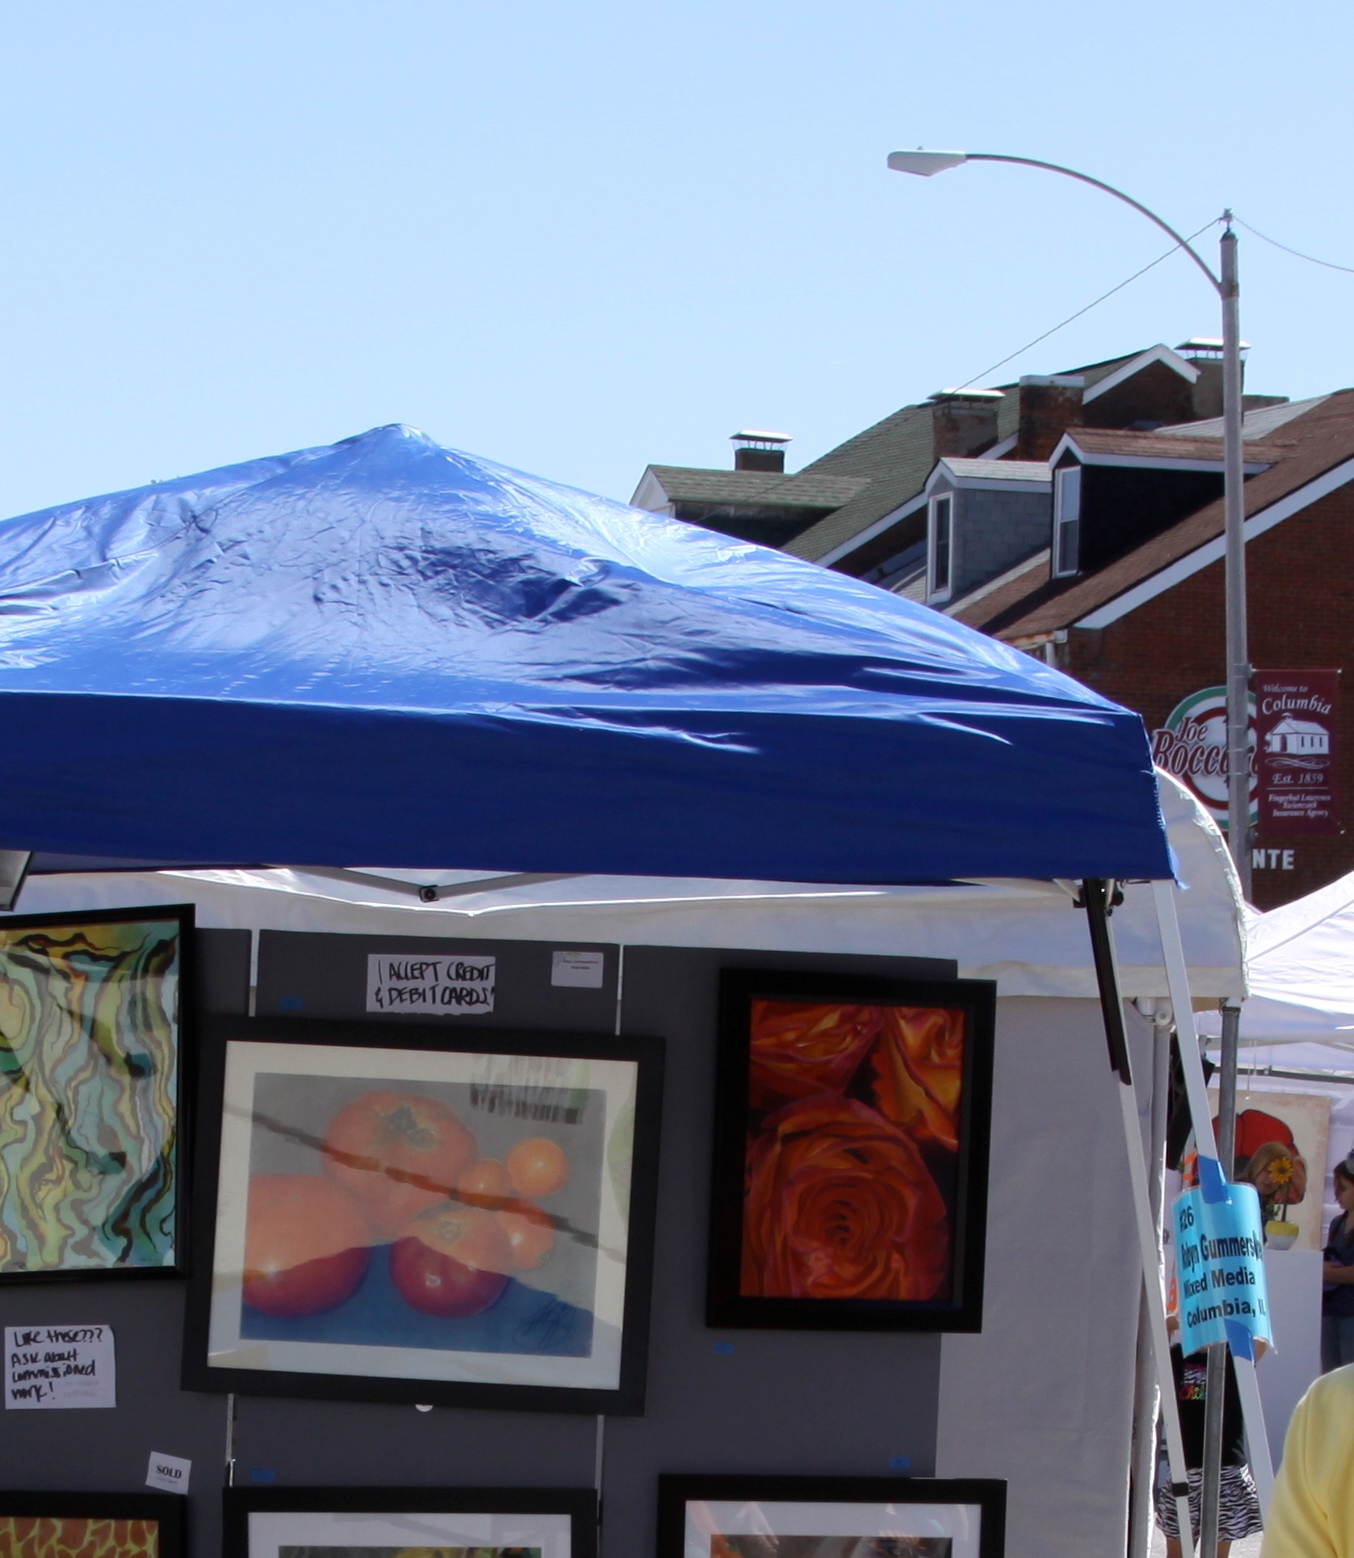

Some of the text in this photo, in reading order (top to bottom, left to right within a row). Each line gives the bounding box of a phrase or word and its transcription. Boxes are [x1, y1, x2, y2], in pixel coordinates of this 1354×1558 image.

[1262, 683, 1308, 692] Welcome to
[1262, 694, 1332, 715] Columbia
[1175, 717, 1208, 742] Joe
[1272, 773, 1324, 784] Est. 1859
[1252, 848, 1295, 870] NTE
[377, 960, 495, 983] I ACCEPT CREDIT
[388, 985, 437, 1006] DEBIT
[1212, 1267, 1256, 1288] Media
[1187, 1298, 1256, 1328] Columbia,
[155, 1464, 182, 1479] SOLD
